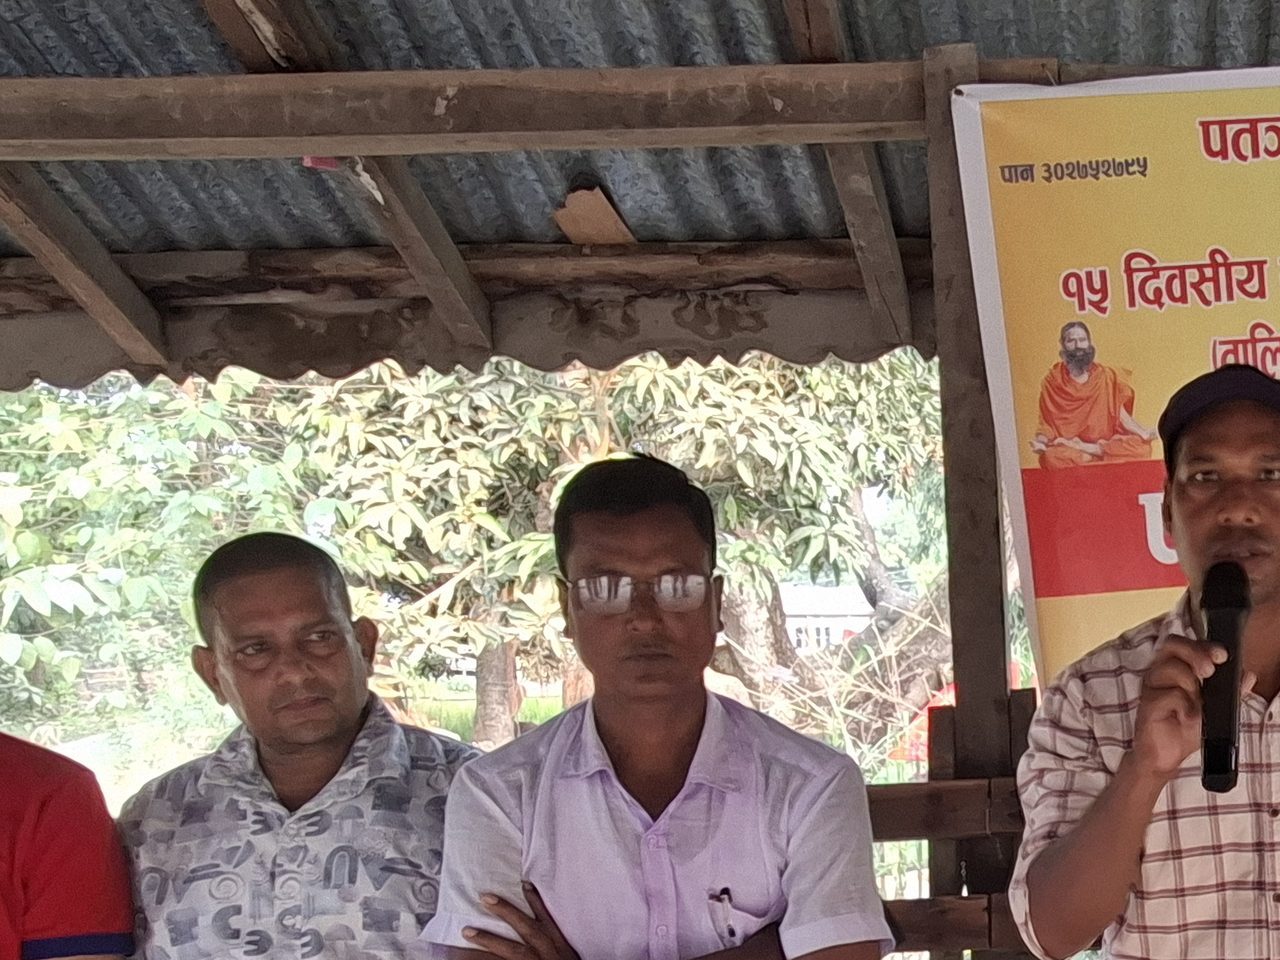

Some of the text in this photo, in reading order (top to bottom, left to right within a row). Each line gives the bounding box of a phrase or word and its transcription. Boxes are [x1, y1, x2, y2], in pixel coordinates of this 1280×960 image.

[999, 164, 1035, 183] पान
[1061, 266, 1109, 315] १५
[1123, 250, 1269, 309] दिवसीय
